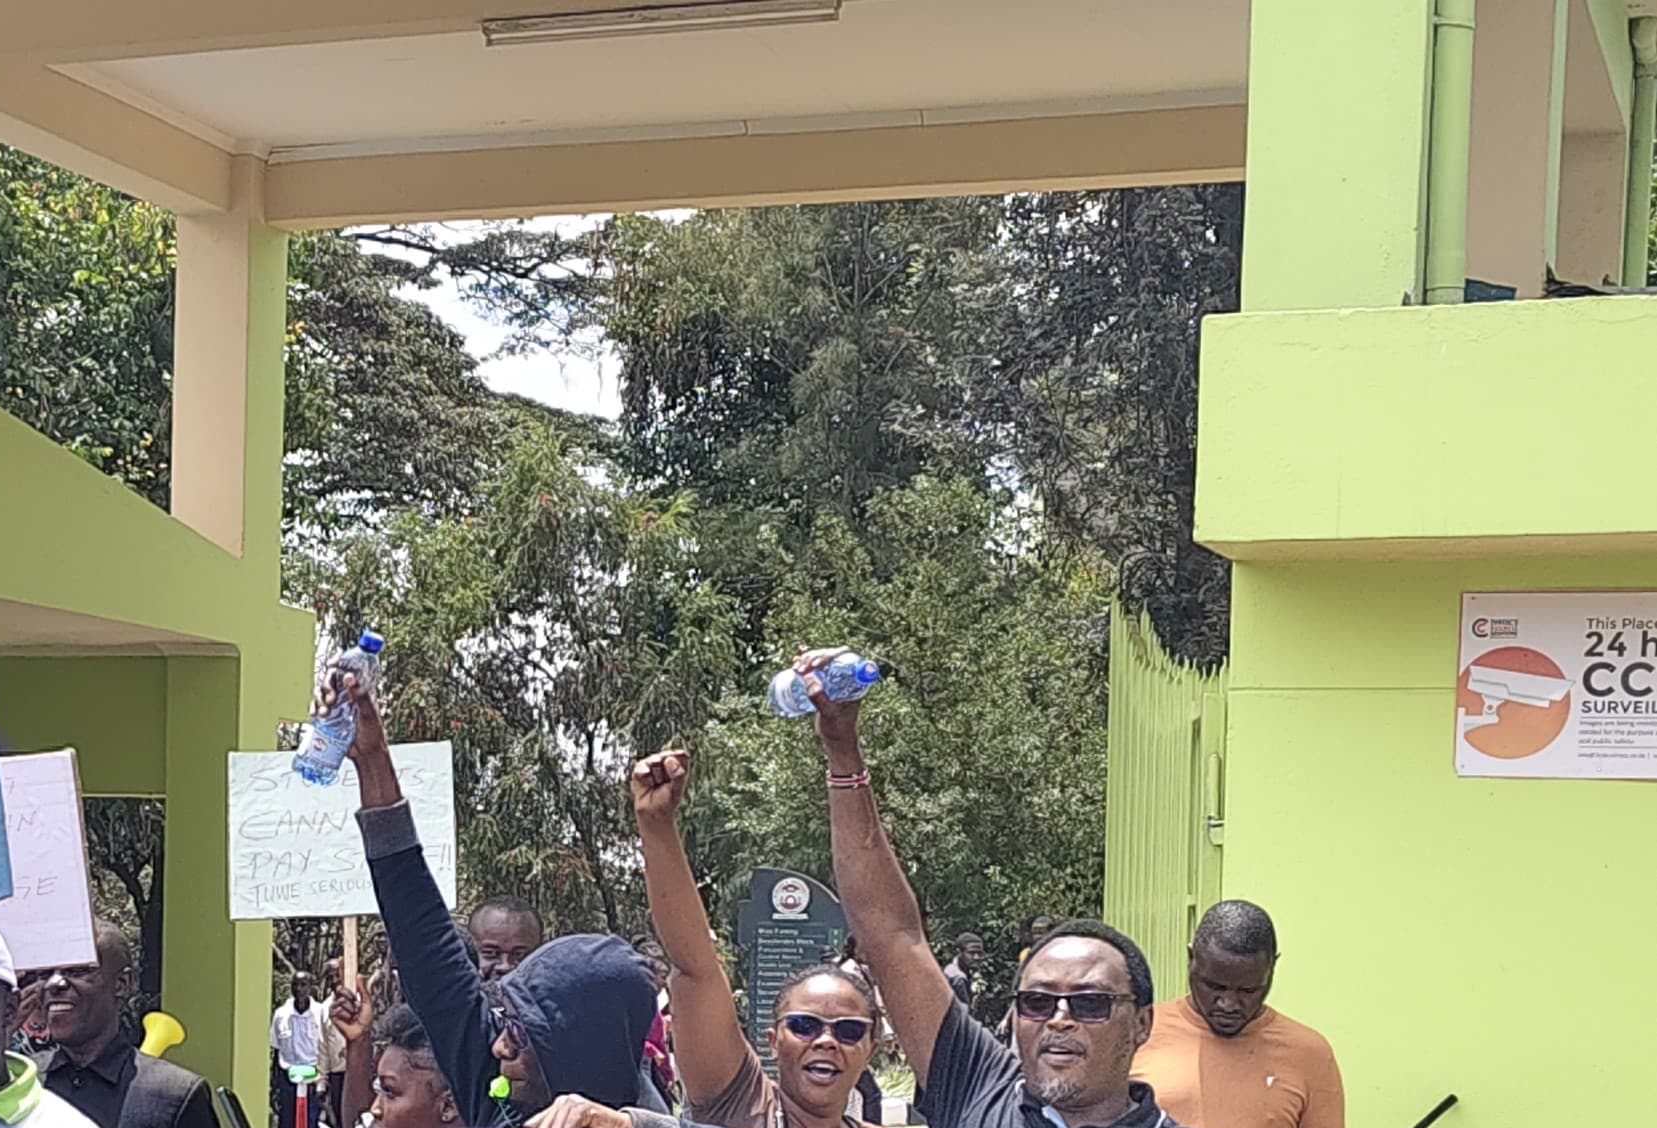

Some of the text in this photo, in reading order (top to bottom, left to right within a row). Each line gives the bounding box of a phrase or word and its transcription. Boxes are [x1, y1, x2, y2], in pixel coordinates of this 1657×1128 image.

[1586, 617, 1616, 630] This
[1584, 631, 1627, 657] 24
[250, 850, 312, 880] PAY
